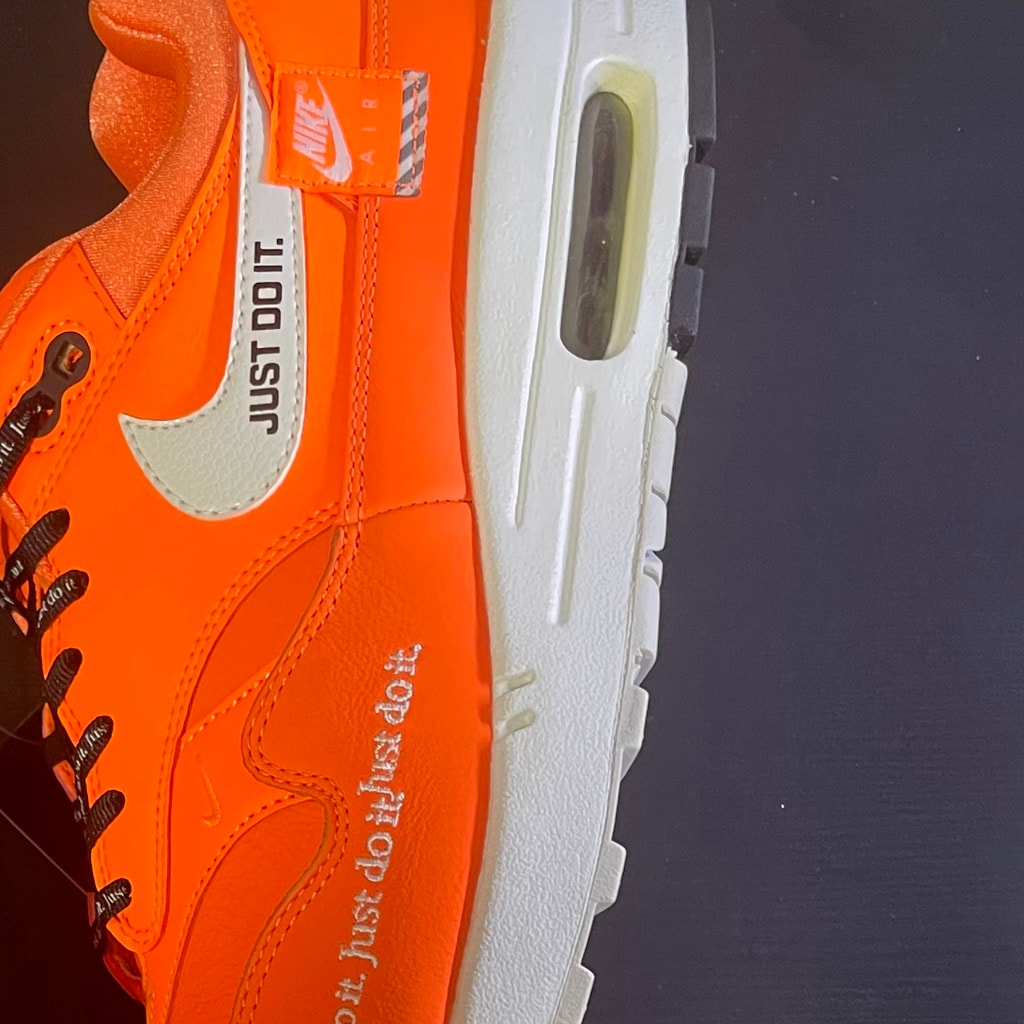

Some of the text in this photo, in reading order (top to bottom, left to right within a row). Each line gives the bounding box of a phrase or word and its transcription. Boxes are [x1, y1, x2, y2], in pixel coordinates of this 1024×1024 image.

[360, 100, 378, 165] AIR
[249, 238, 284, 435] JUST DO IT.
[384, 643, 422, 676] it.
[375, 679, 414, 725] do
[357, 730, 402, 802] Just
[355, 831, 393, 882] do
[338, 888, 383, 968] Just
[334, 972, 367, 1006] it.
